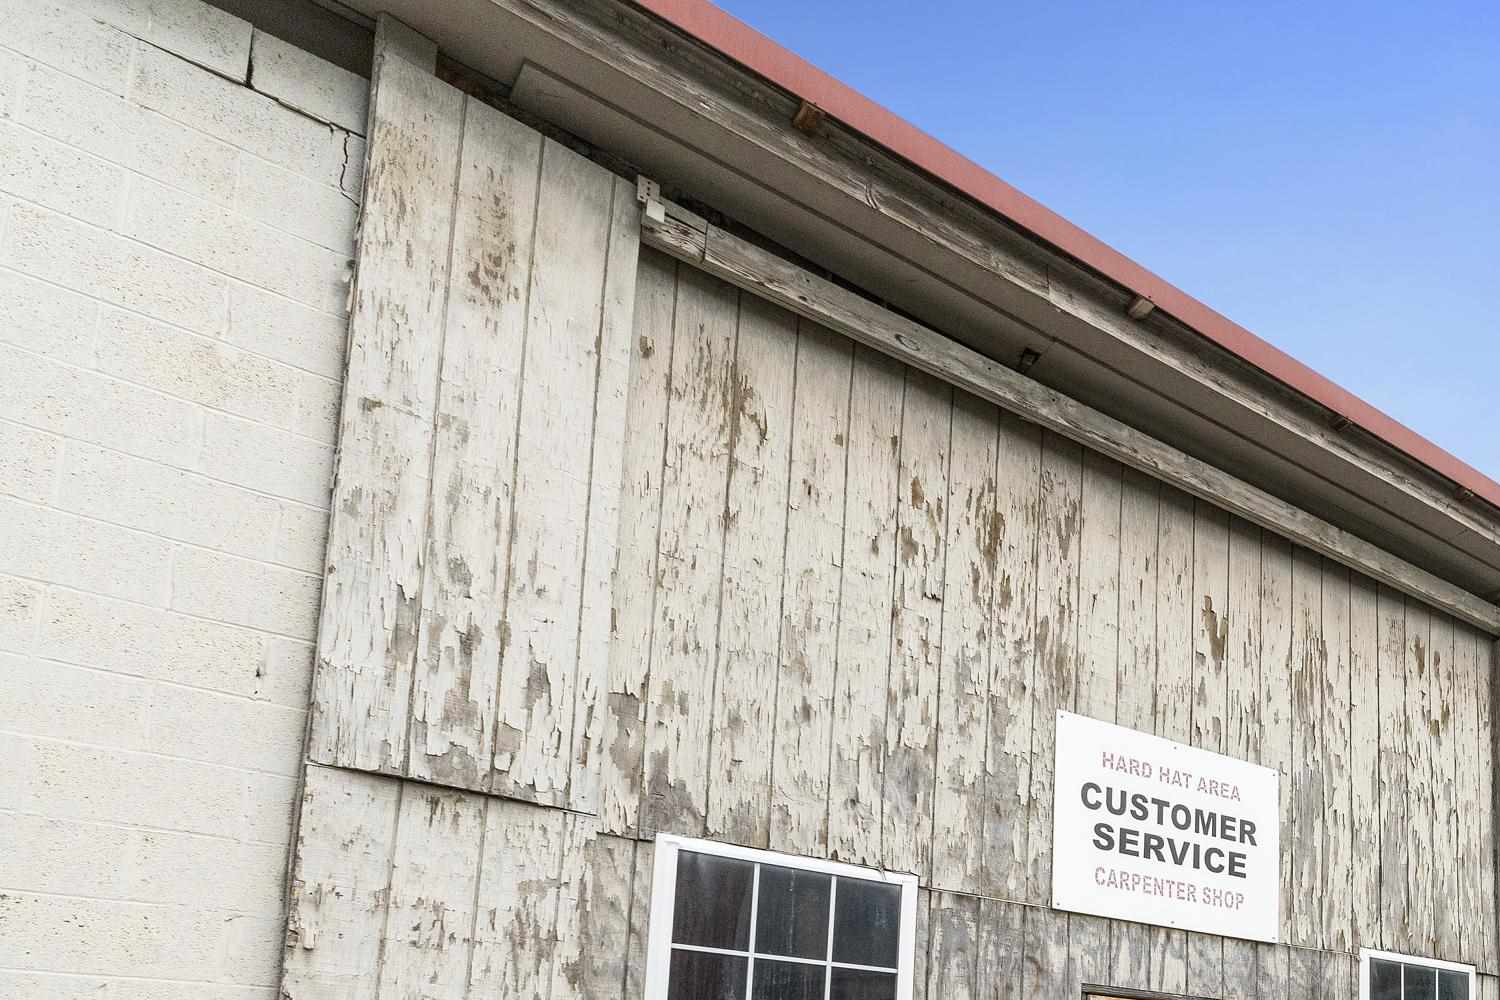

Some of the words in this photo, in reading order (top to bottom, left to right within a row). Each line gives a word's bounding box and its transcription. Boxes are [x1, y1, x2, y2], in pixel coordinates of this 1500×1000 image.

[1101, 751, 1153, 779] HARD
[1159, 766, 1192, 789] HAT
[1196, 777, 1241, 802] AREA
[1080, 782, 1258, 847] CUSTOMER
[1092, 822, 1248, 879] SERVICE
[1095, 866, 1197, 903] CARPENTER
[1202, 886, 1245, 911] SHOP
